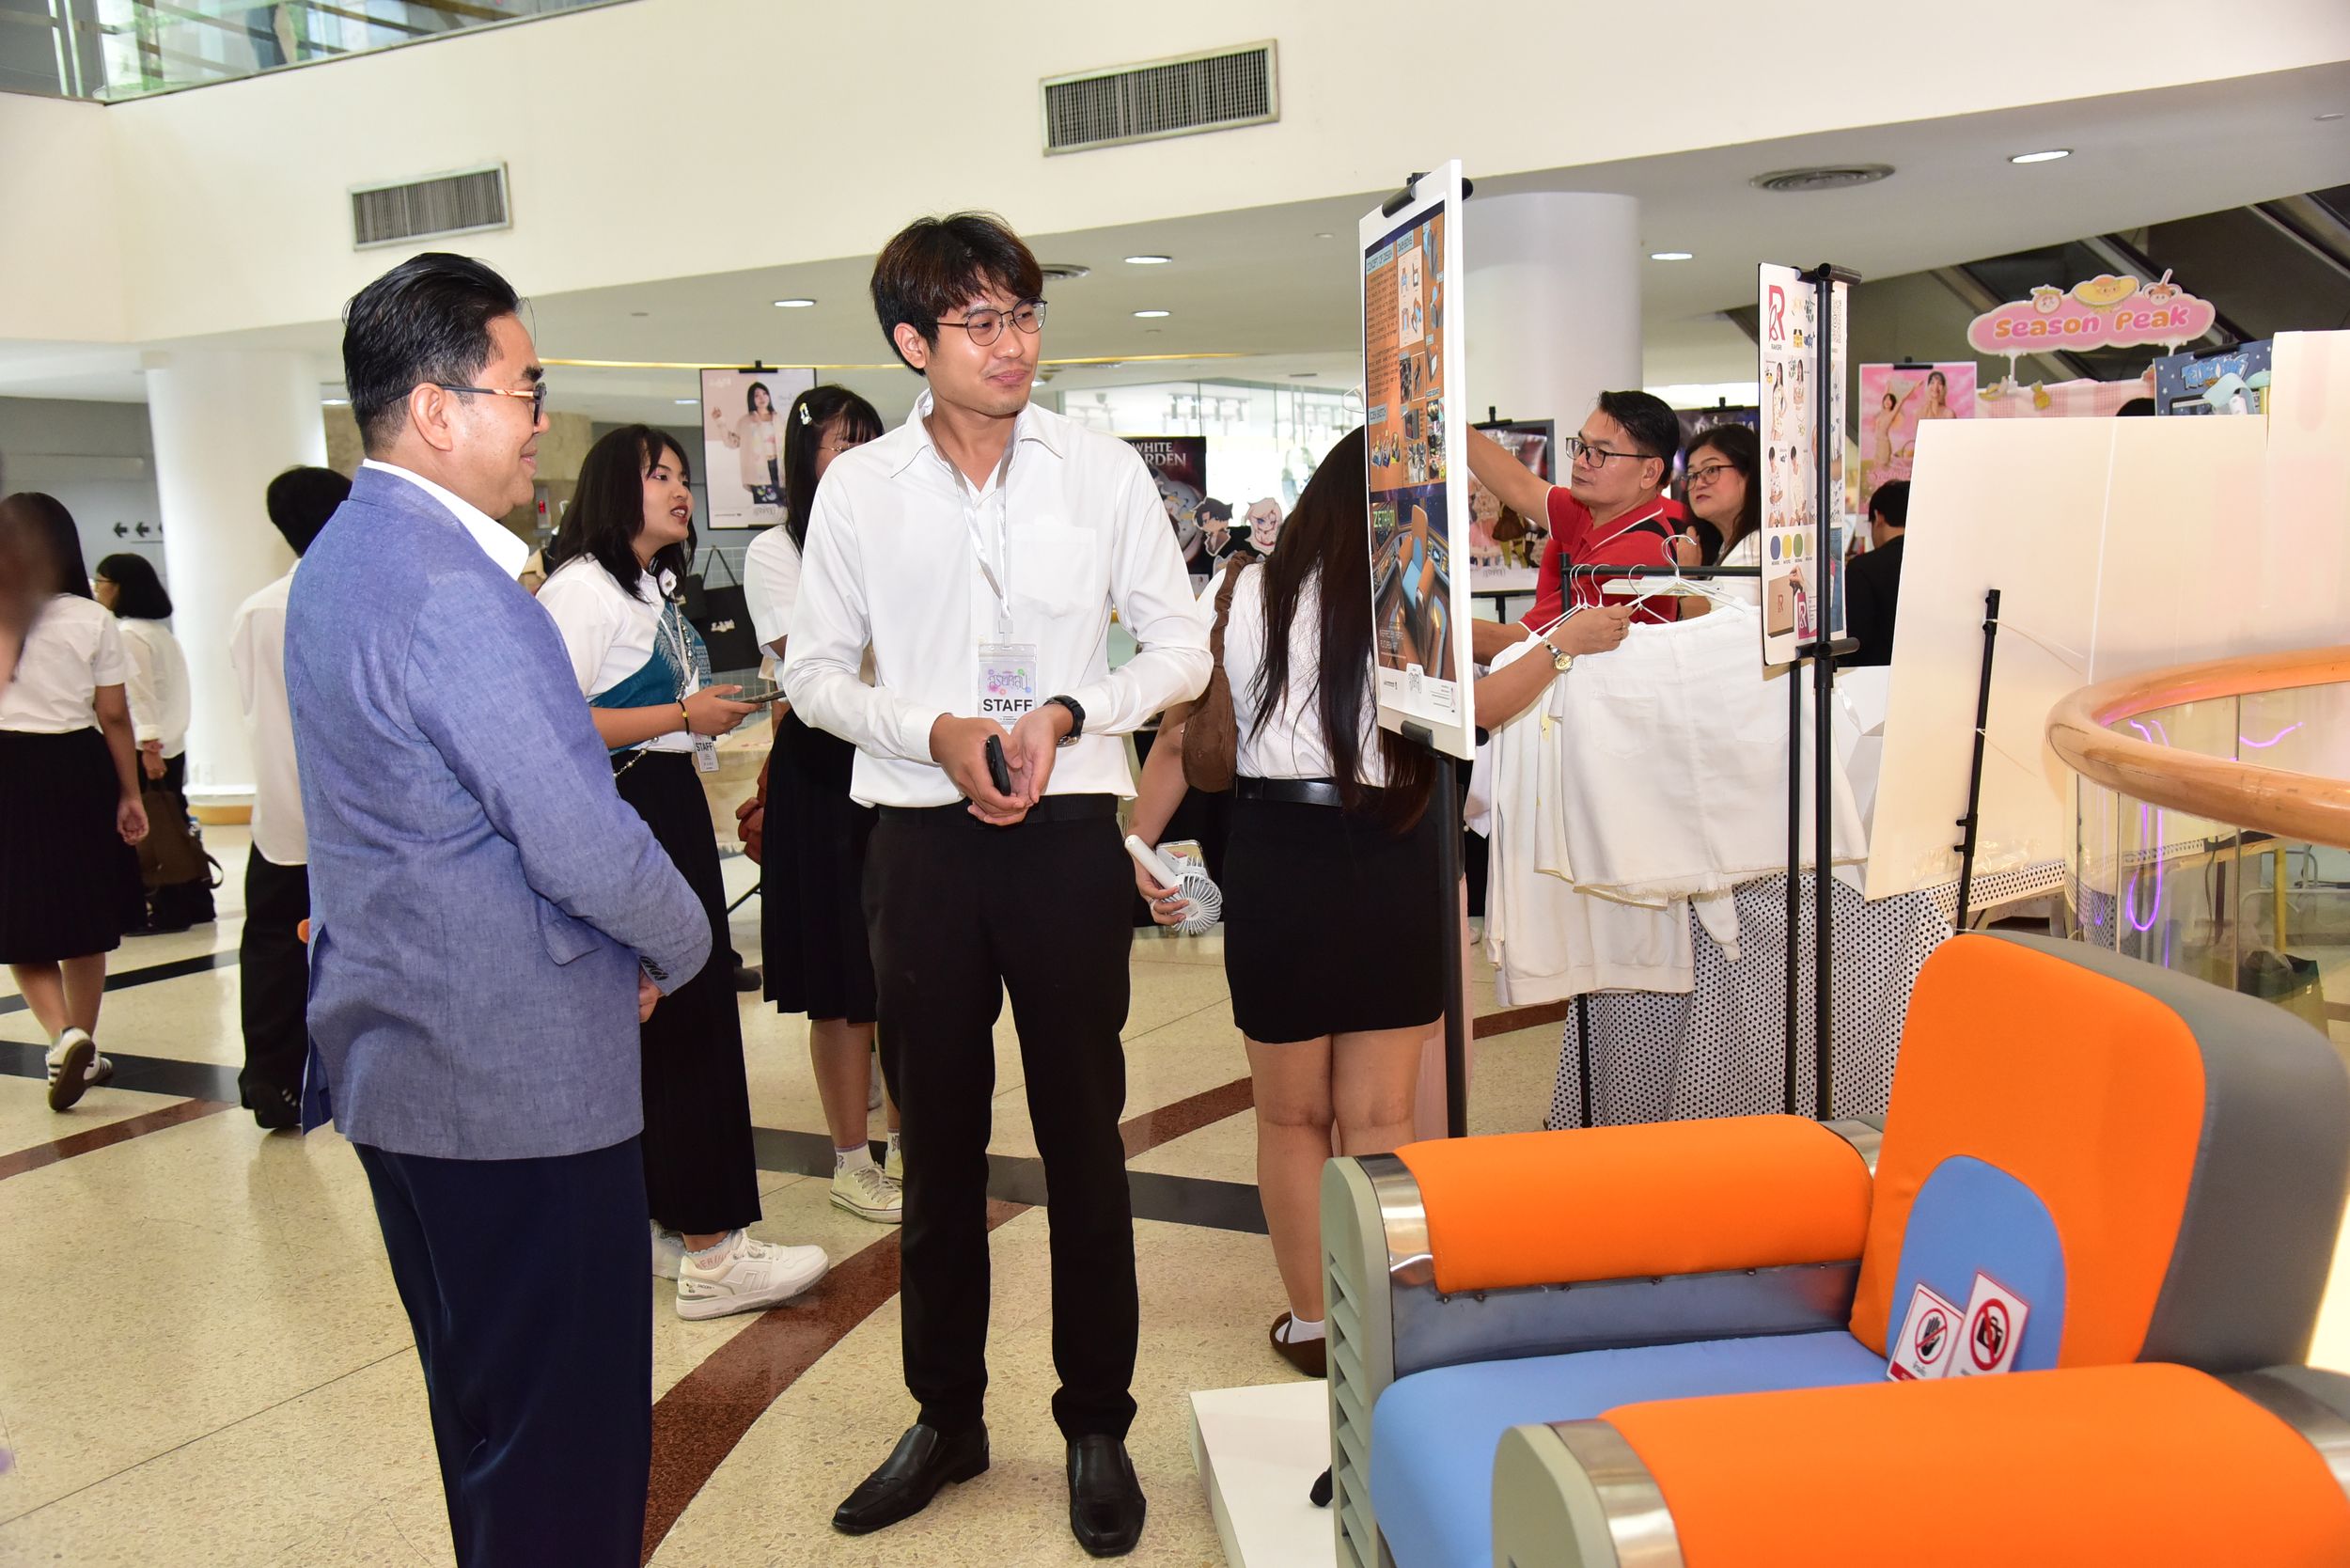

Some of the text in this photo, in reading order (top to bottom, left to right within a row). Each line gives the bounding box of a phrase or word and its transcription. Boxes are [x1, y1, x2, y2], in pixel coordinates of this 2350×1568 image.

[1995, 306, 2189, 338] Season Peak
[1131, 442, 1173, 453] WHITE
[1144, 453, 1186, 467] RDEN
[983, 698, 1033, 712] STAFF
[696, 742, 713, 752] STAFF
